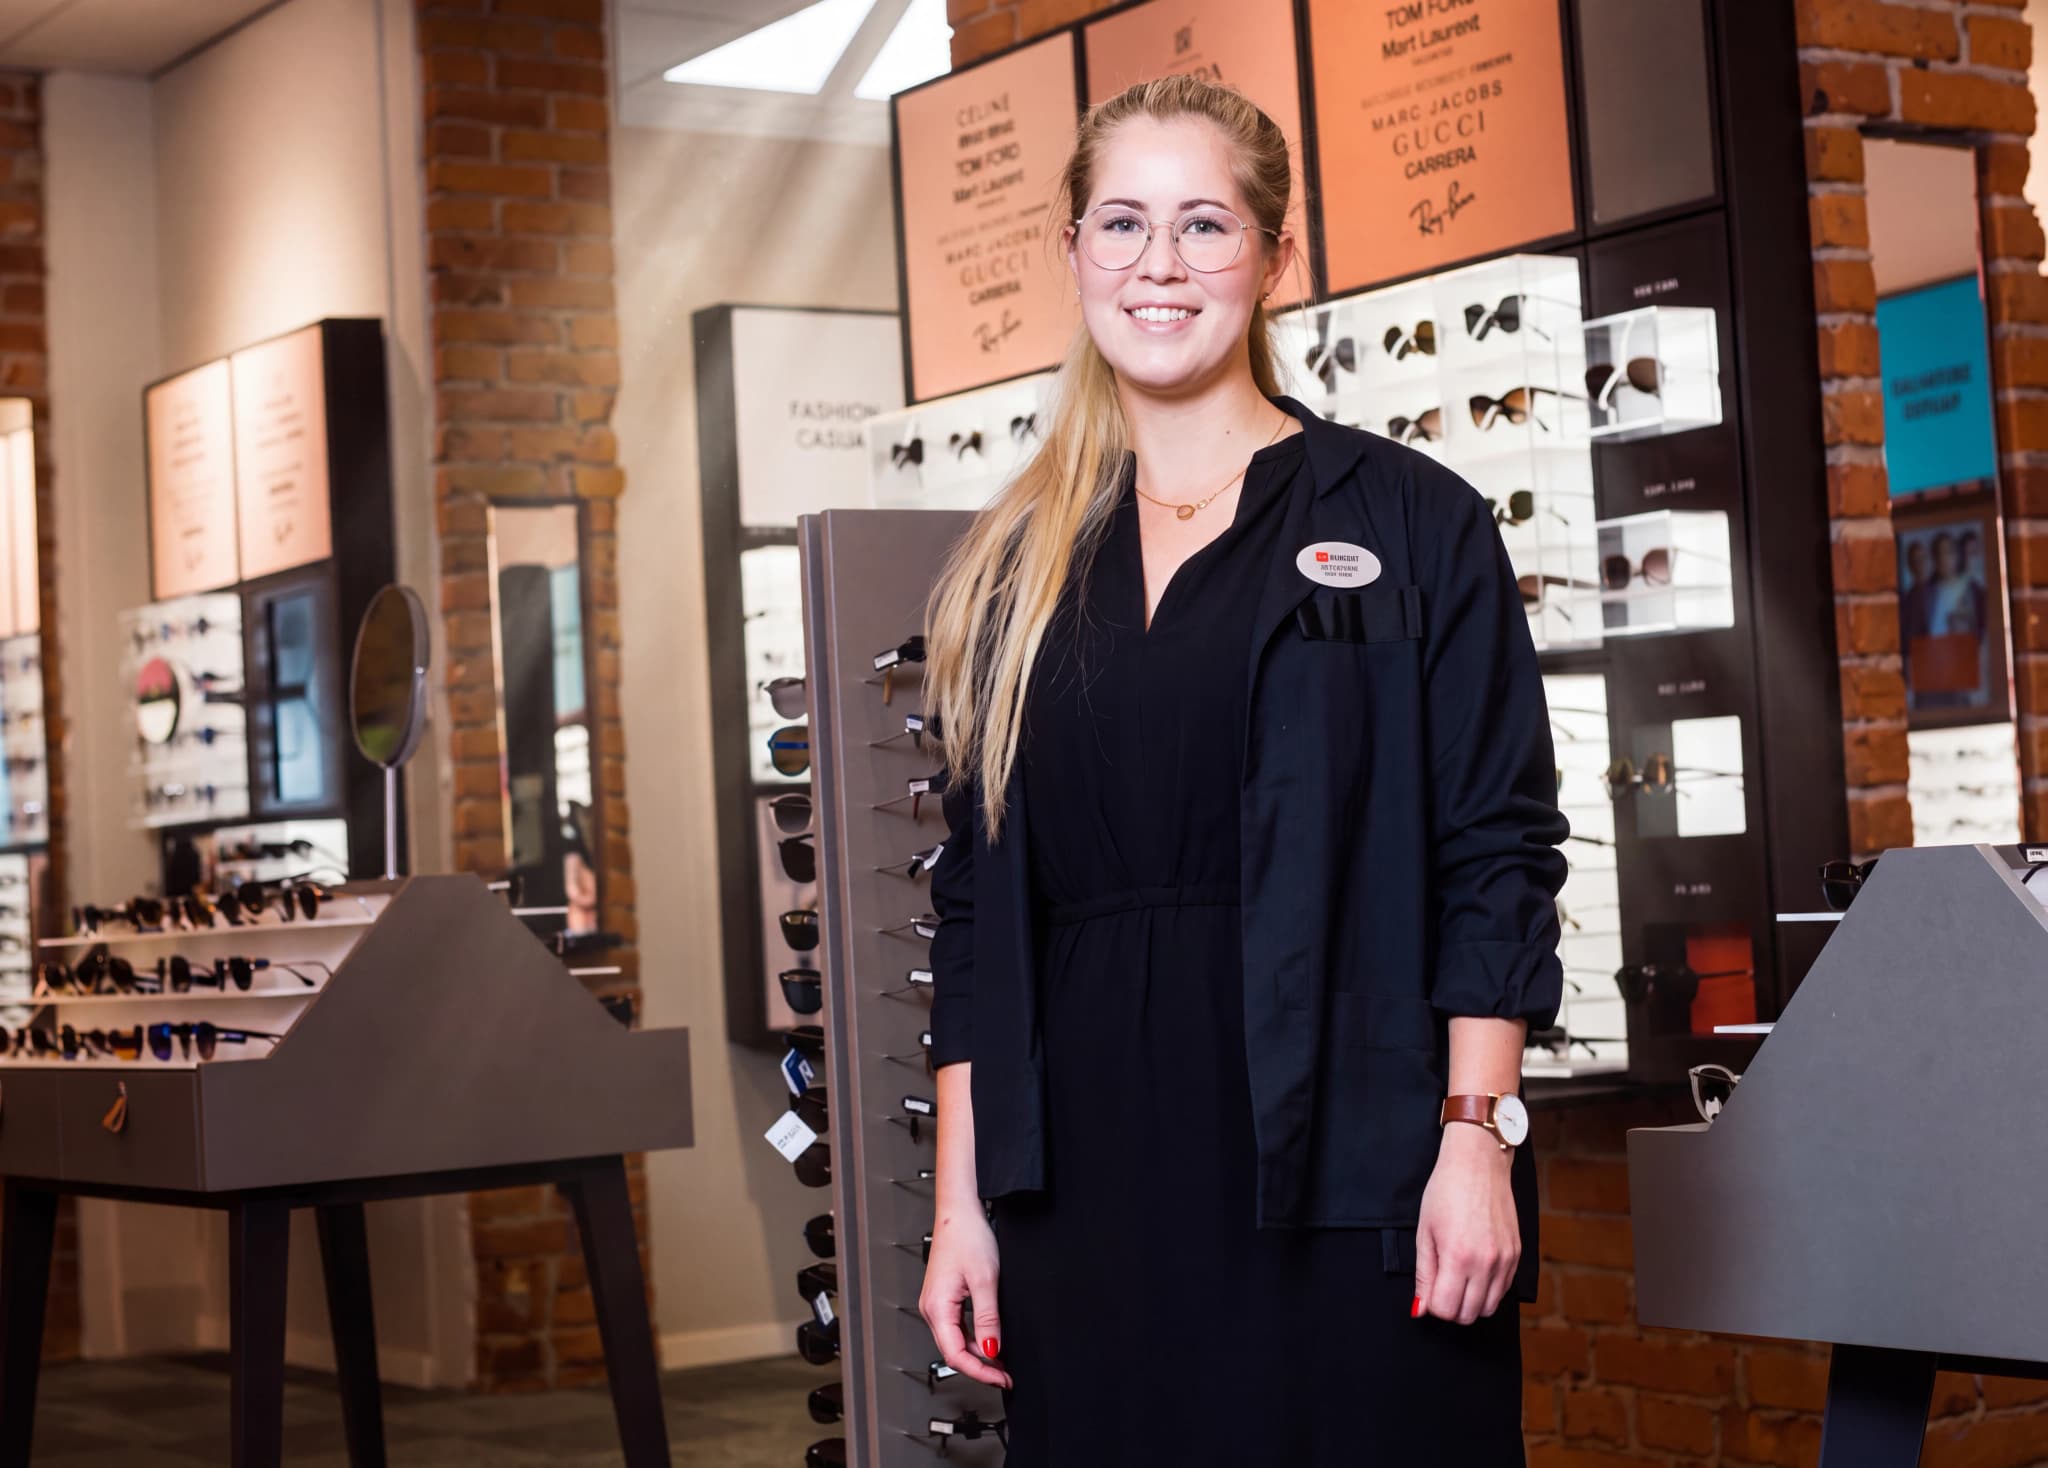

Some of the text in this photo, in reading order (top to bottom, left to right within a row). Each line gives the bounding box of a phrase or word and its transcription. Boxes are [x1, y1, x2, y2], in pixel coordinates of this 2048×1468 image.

[1385, 1, 1422, 30] TOM
[1420, 14, 1481, 48] Laurent
[1372, 104, 1420, 131] MARC
[1430, 80, 1503, 115] JACOBS
[1393, 109, 1484, 156] GUCCI
[1405, 146, 1477, 179] CARRERA
[960, 250, 1028, 287] GUCCI
[794, 427, 865, 450] CASUA
